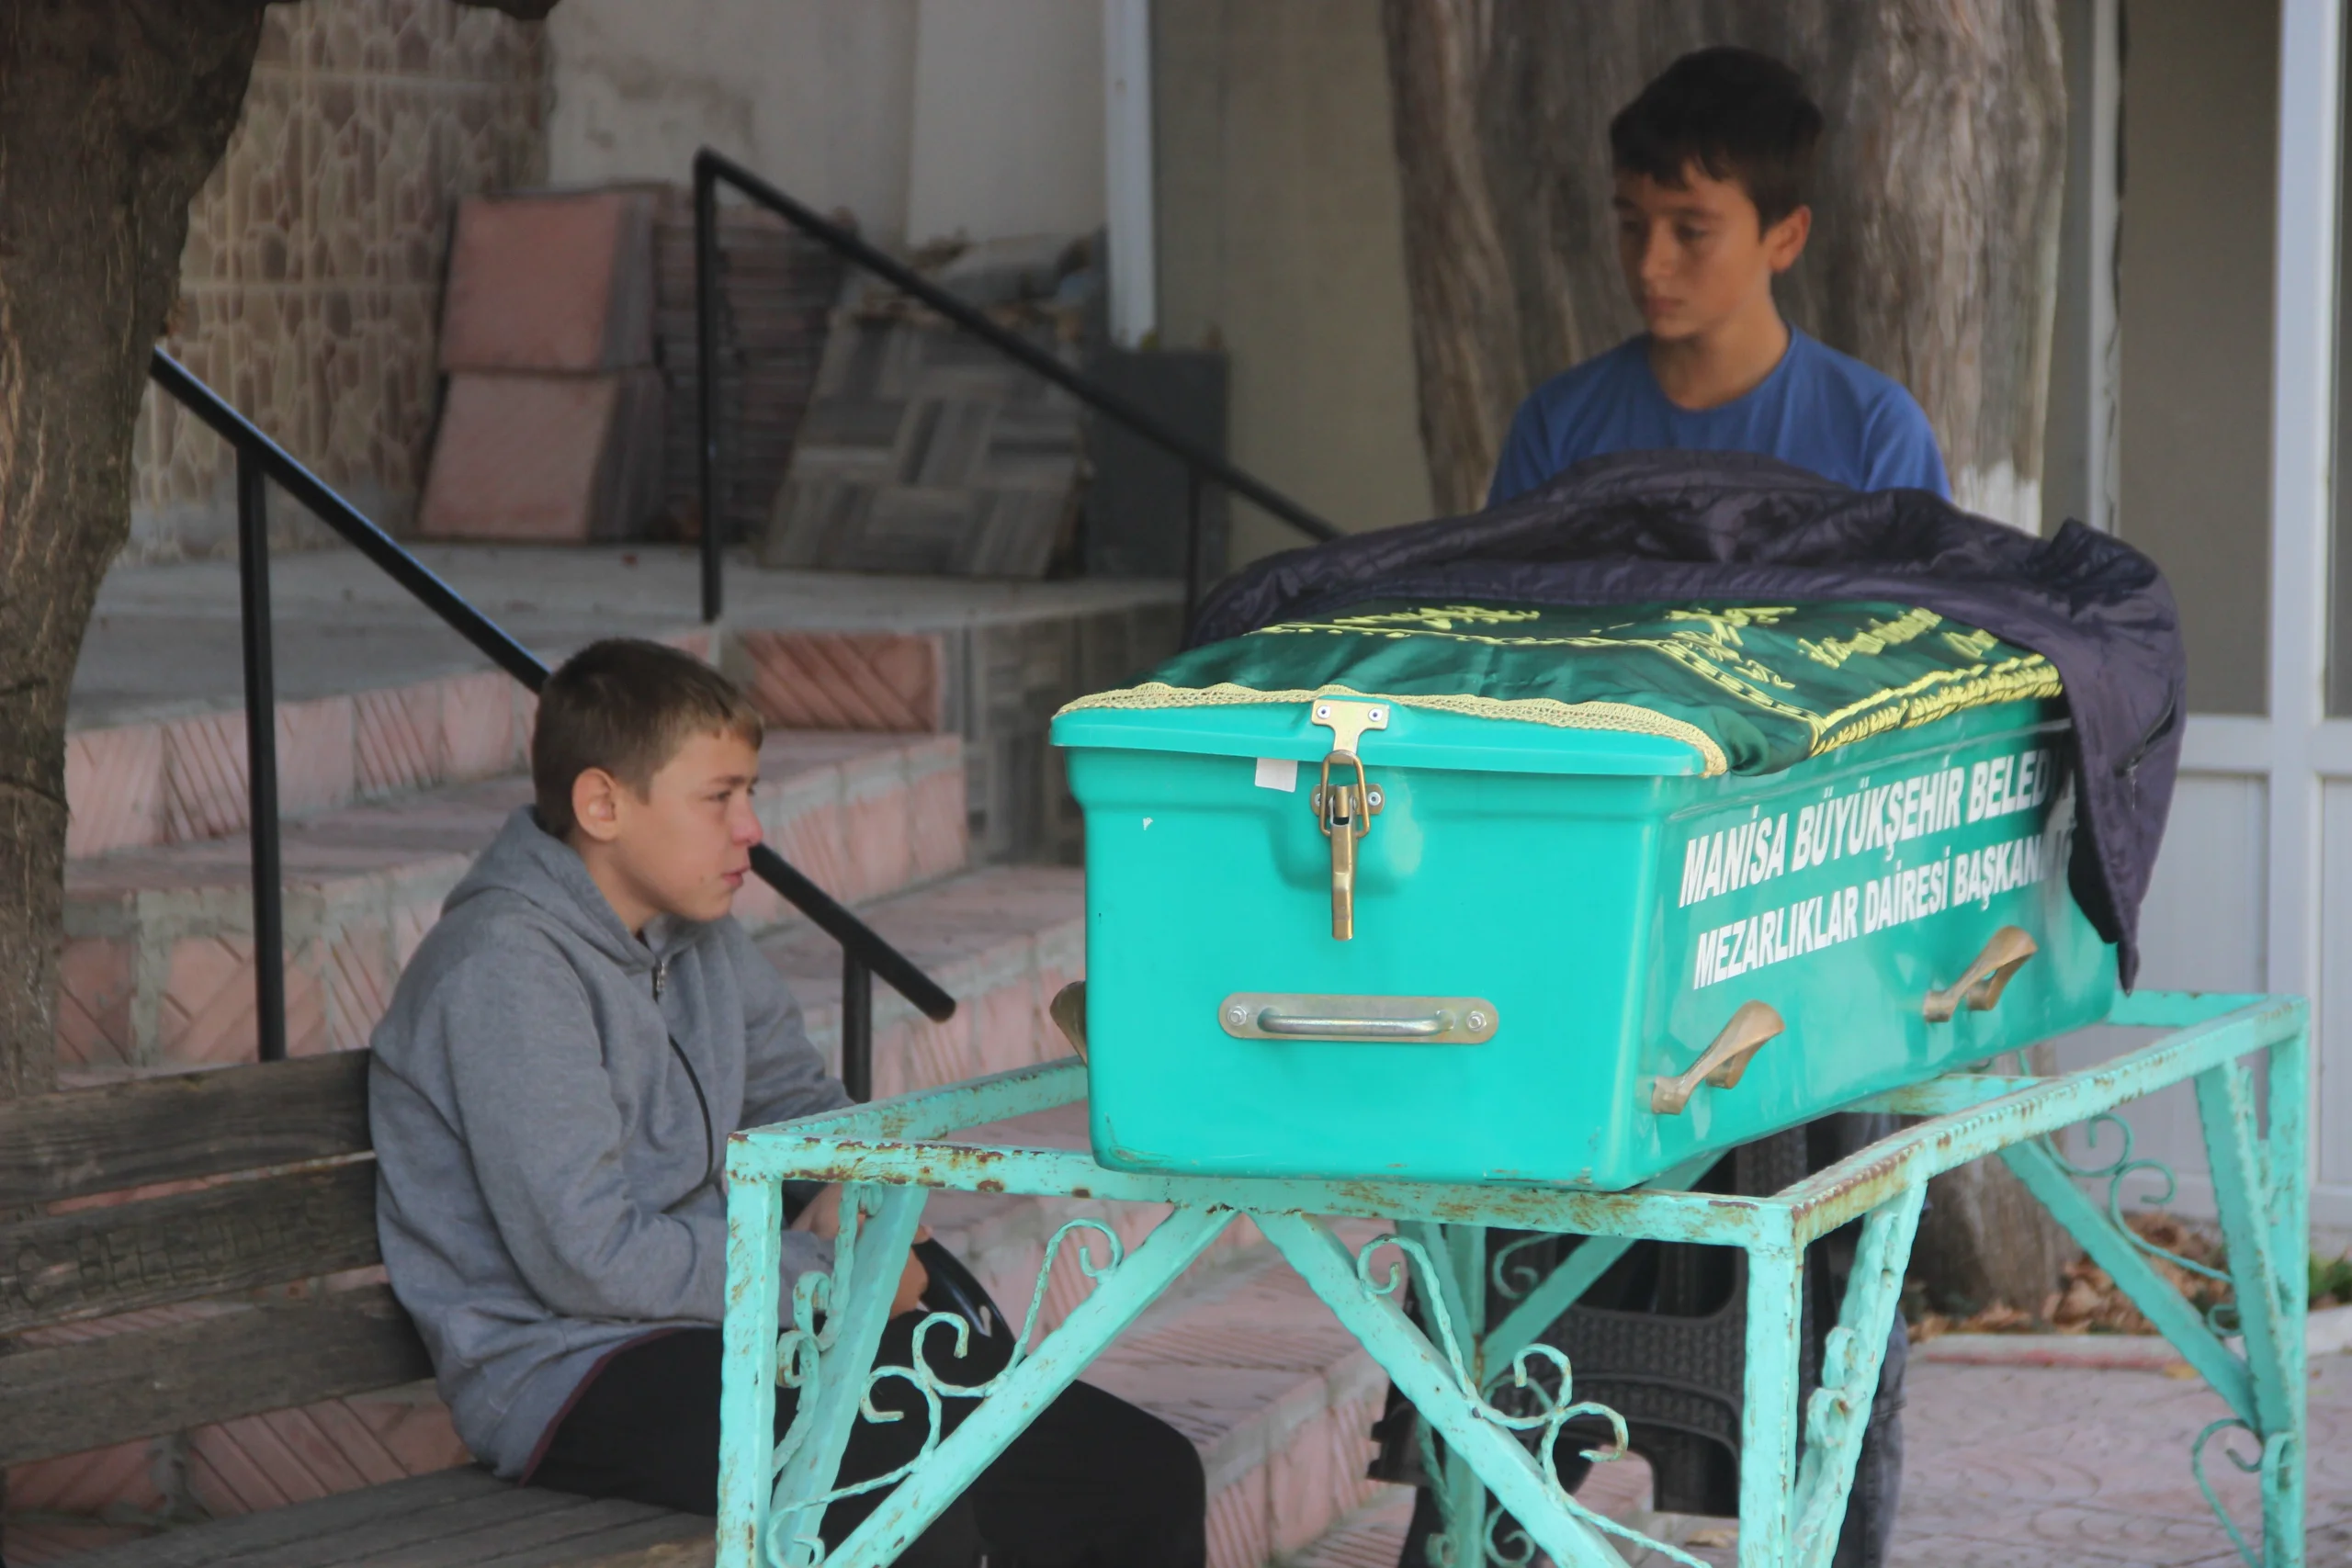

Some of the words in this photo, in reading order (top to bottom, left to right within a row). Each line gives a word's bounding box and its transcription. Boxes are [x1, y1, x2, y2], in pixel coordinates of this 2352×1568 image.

[1679, 805, 1789, 908] MANİSA
[1791, 753, 1966, 872] BÜYÜKŞEHİR
[1967, 748, 2052, 824] BELED
[1693, 885, 1859, 990] MEZARLIKLAR
[1863, 846, 1951, 935] DAİRESİ
